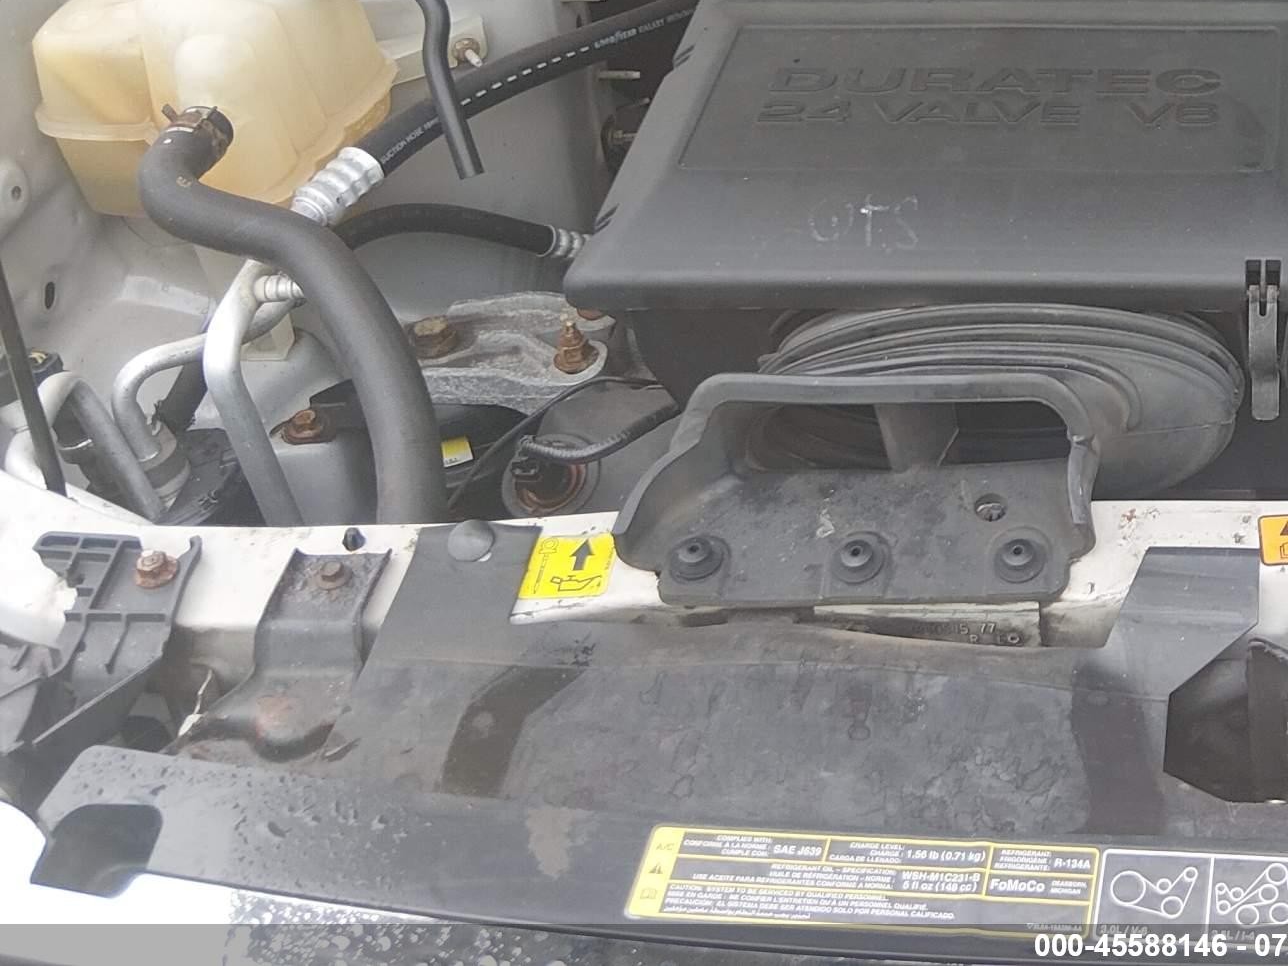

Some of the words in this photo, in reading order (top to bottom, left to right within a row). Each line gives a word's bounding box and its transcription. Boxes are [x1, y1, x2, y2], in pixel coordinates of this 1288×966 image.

[767, 67, 1222, 96] DURATEC
[757, 100, 852, 125] 24
[873, 100, 1082, 126] VALVE
[772, 844, 797, 854] SAE
[796, 845, 822, 856] J639
[906, 849, 927, 858] 1.56
[940, 850, 966, 862] (0.71
[967, 850, 986, 863] kg)
[1053, 857, 1091, 869] R-134A
[989, 878, 1045, 892] FoMoCo
